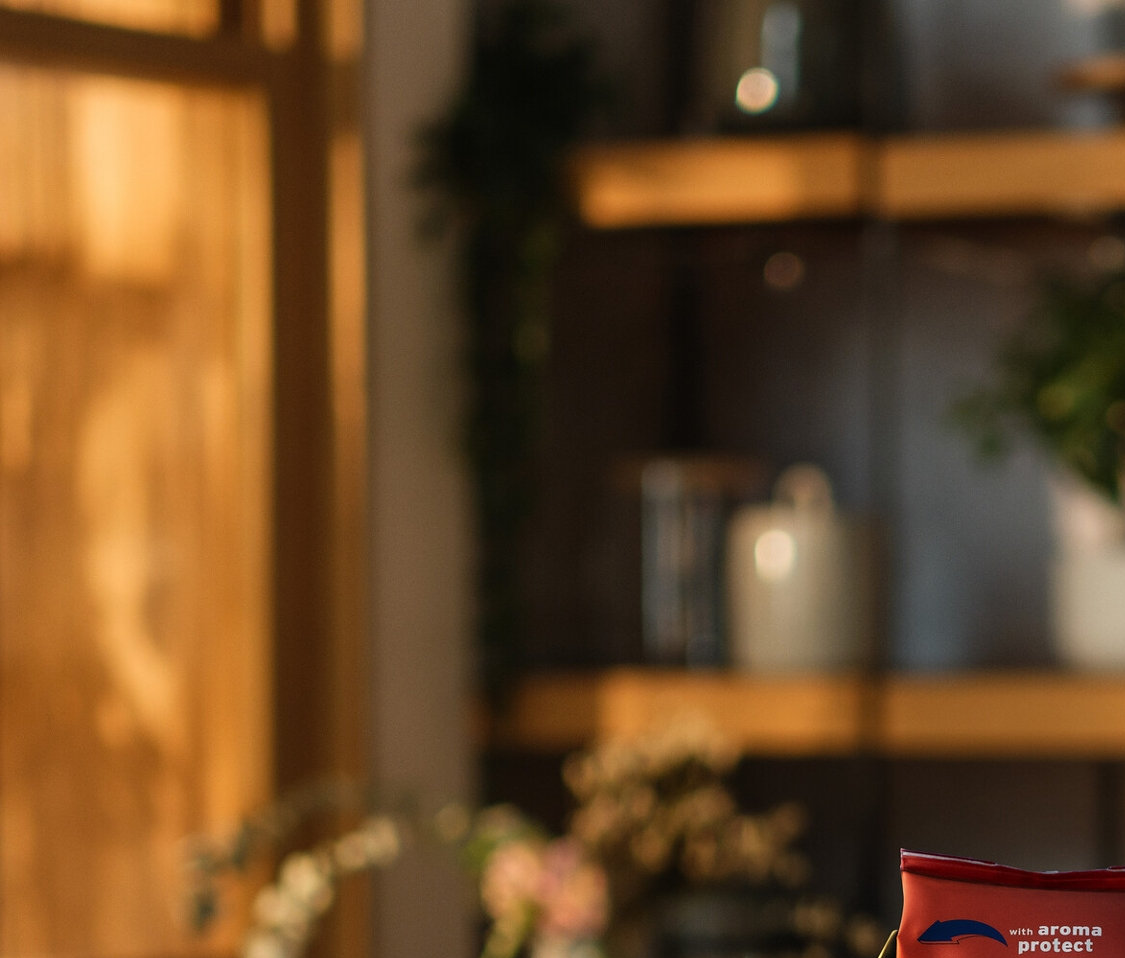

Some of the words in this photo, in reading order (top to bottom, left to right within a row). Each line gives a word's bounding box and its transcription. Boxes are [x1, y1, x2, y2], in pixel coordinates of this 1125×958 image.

[1009, 927, 1033, 936] with
[1037, 923, 1102, 937] aroma
[1017, 938, 1093, 955] protect
